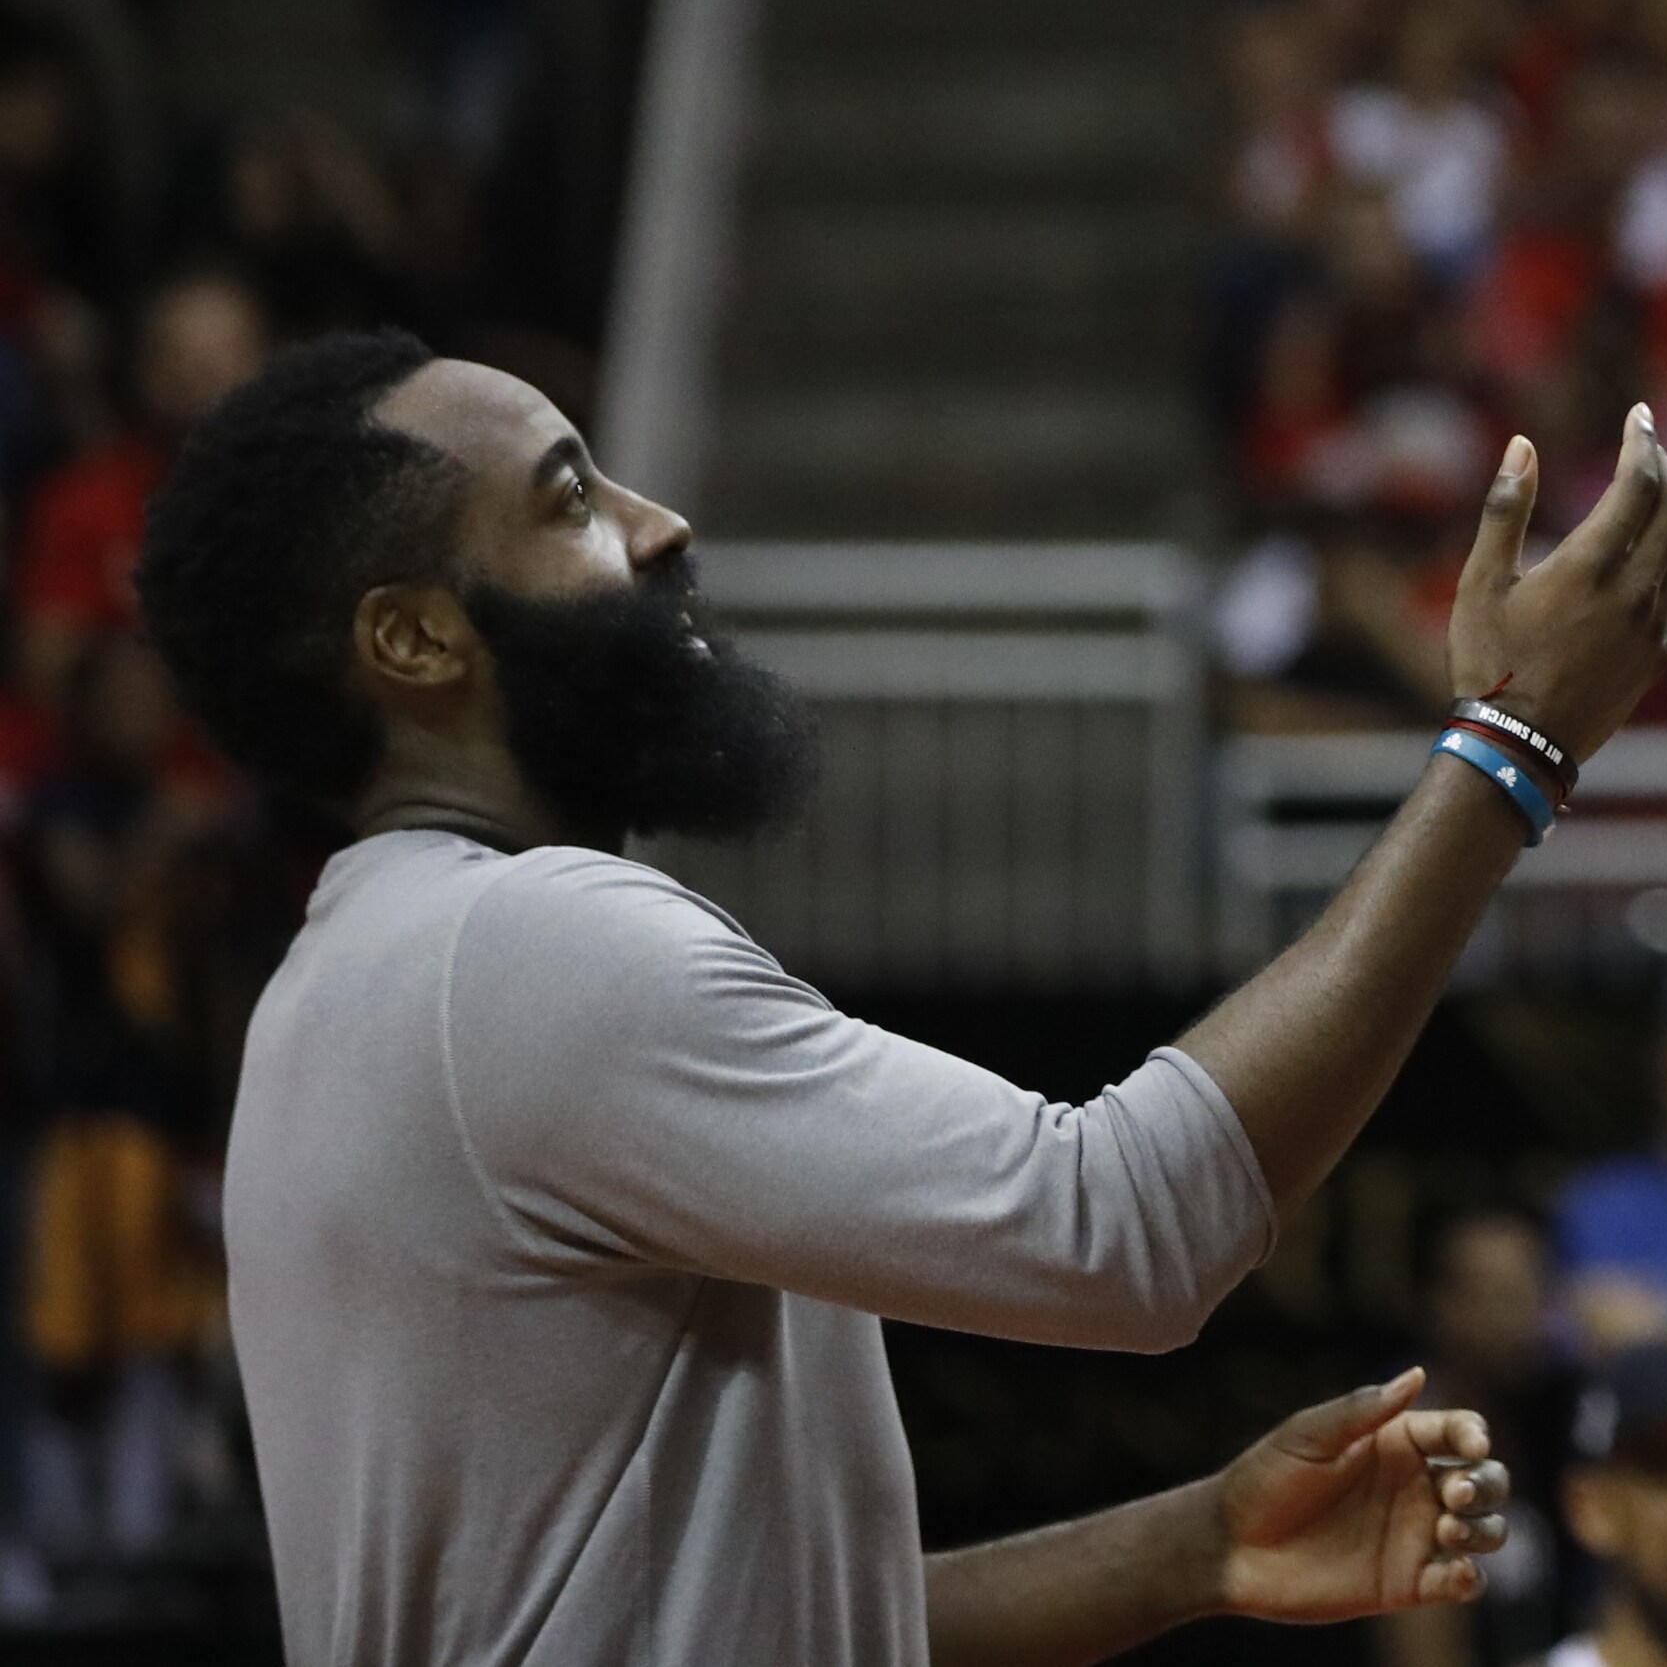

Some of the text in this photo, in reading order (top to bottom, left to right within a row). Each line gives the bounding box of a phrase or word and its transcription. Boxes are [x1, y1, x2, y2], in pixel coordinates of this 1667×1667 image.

[1479, 706, 1563, 765] HIT UR SWITCH
